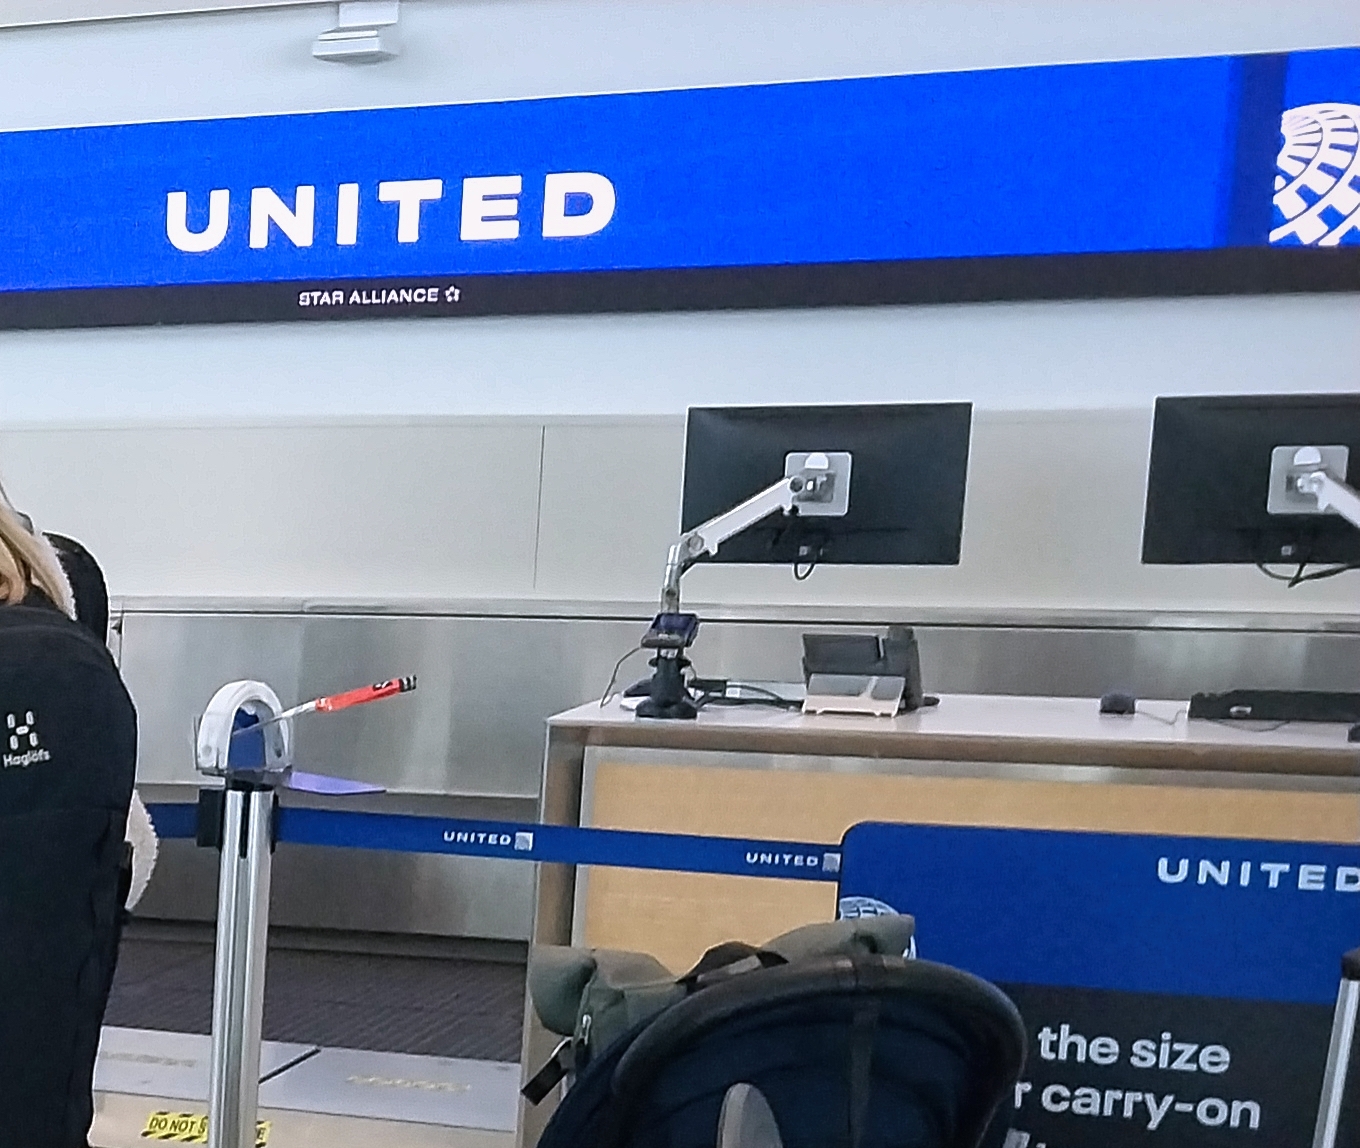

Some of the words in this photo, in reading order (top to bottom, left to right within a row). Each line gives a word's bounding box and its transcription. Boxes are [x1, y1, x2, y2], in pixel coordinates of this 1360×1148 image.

[165, 171, 617, 253] UNITED
[298, 290, 344, 307] STAR
[348, 286, 440, 306] ALLIANCE
[443, 829, 512, 846] UNITED
[746, 851, 819, 868] UNITED
[1156, 856, 1360, 893] UNITED
[1037, 1023, 1120, 1066] the
[1130, 1031, 1231, 1075] size
[1041, 1079, 1261, 1130] carry-on
[148, 1117, 169, 1132] DO
[170, 1118, 197, 1134] NOT
